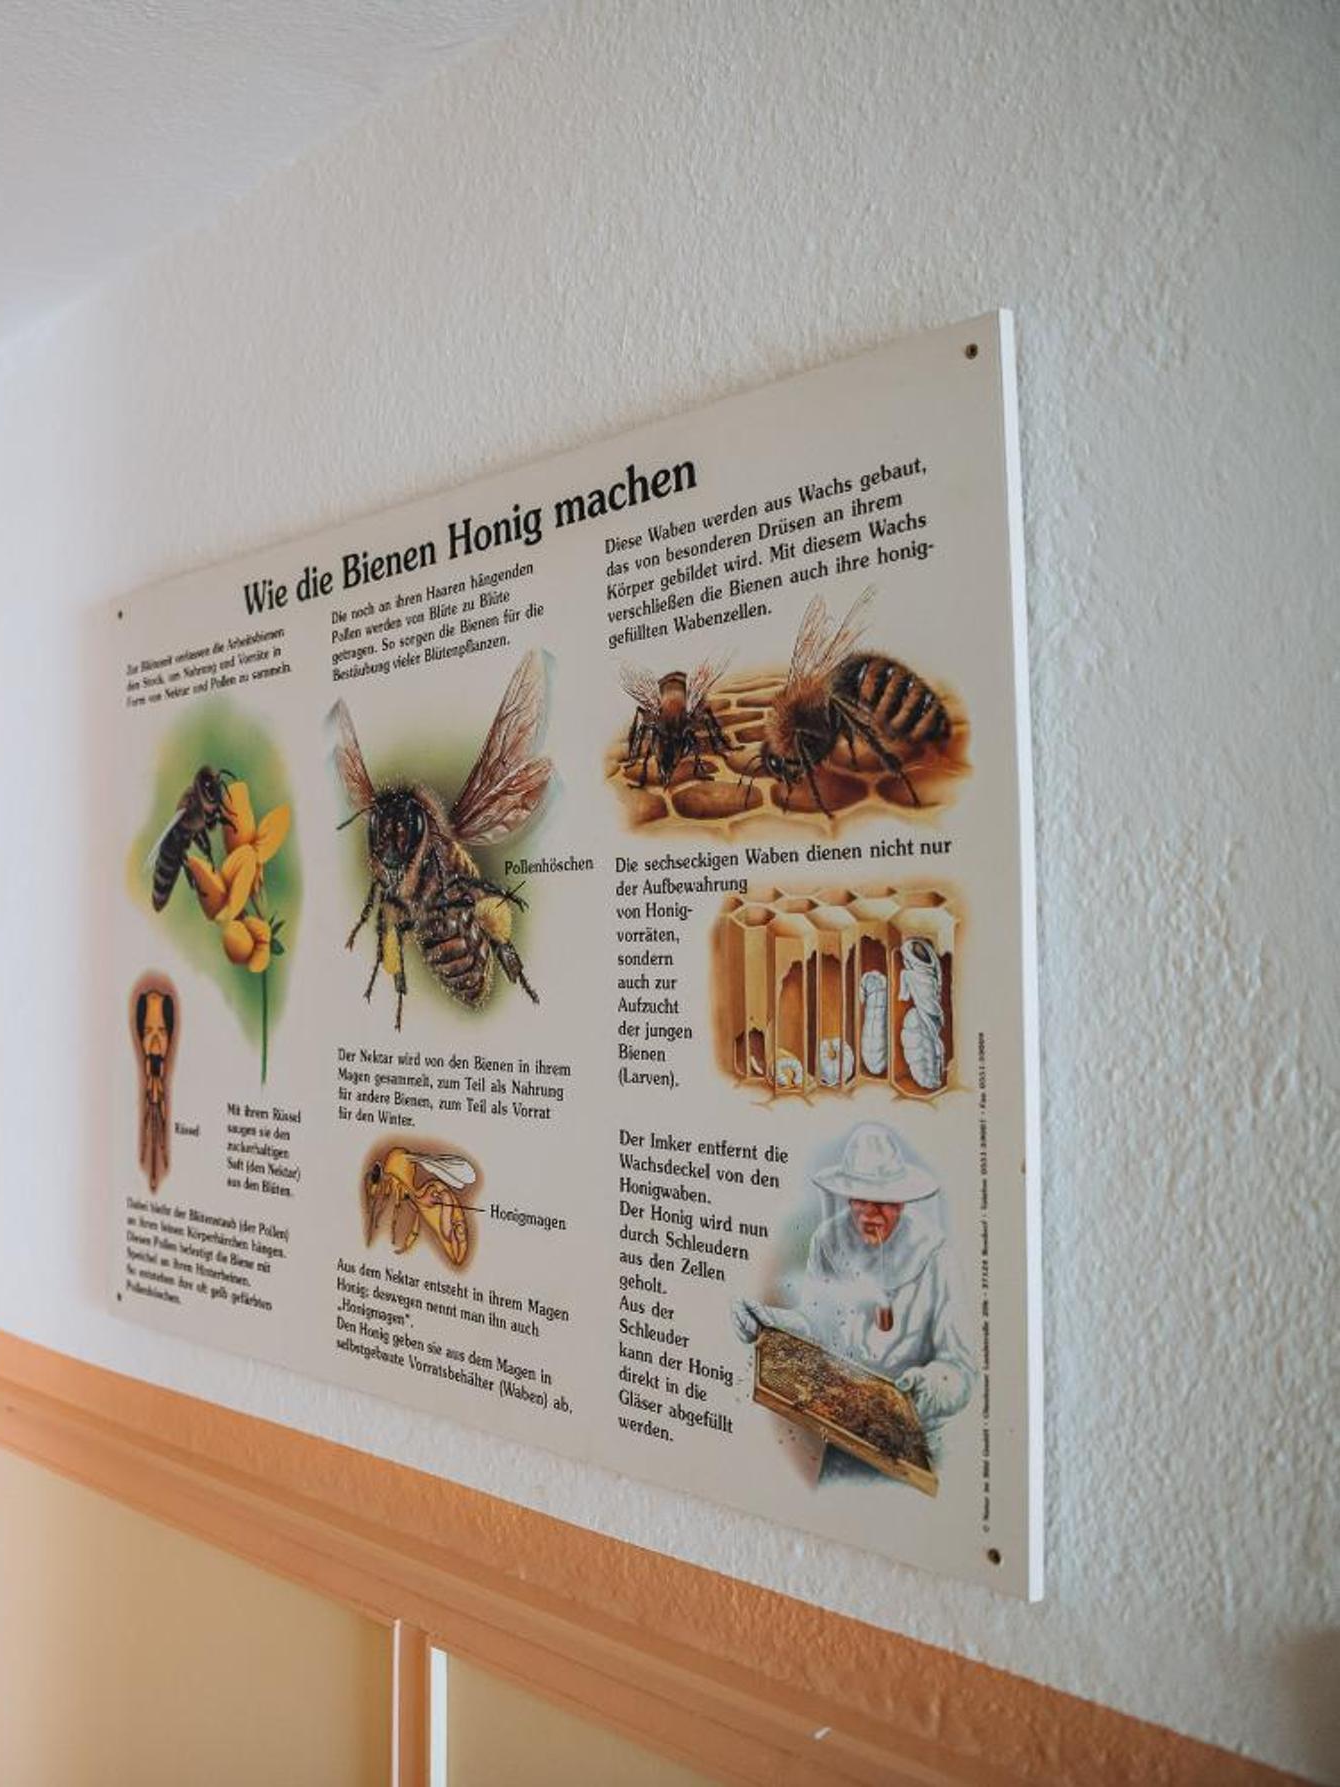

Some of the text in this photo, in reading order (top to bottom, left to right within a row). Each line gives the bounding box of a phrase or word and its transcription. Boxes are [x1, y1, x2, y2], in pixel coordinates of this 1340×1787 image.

[605, 457, 926, 554] Diese Waben werden aus Wachs gebaut,
[243, 461, 697, 615] Wie die Bienen Honig machen
[605, 492, 902, 577] das von besonderen Drüsen an ihrem
[606, 511, 926, 600] Körper gebildet wird. Mit diesem Wachs
[331, 562, 533, 624] Die noch an ihren Haaren hängenden
[607, 540, 934, 623] verschließen die Bienen auch ihre honig-
[381, 637, 395, 651] So
[399, 631, 435, 648] sorgen
[438, 623, 455, 639] die
[459, 615, 499, 634] Bienen
[503, 608, 522, 625] für
[524, 602, 544, 620] die
[608, 601, 772, 649] gefüllten Wabenzellen.
[392, 651, 421, 669] vieler
[424, 635, 510, 663] Blütenpflanzen.
[505, 855, 594, 874] Pollenhöschen
[615, 838, 952, 873] Die sechseckigen Waben dienen nicht nur
[615, 875, 747, 897] der Aufbewahrung
[615, 901, 693, 921] von Honig-
[616, 926, 679, 944] vorräten,
[617, 949, 674, 966] sondern
[617, 973, 678, 991] auch zur
[617, 996, 679, 1014] Aufzucht
[617, 1020, 692, 1042] der jungen
[337, 1047, 571, 1077] Der Nektar wird von den Bienen in ihrem
[618, 1043, 665, 1063] Bienen
[337, 1066, 564, 1101] Magen gesammelt, zum Teil als Nahrung
[618, 1066, 679, 1090] (Larven).
[338, 1086, 551, 1120] für andere Bienen, zum Teil als Vorrat
[338, 1105, 415, 1127] für den Winter.
[619, 1129, 788, 1164] Der Imker entfernt die
[619, 1152, 779, 1188] Wachsdeckel von den
[619, 1175, 711, 1204] Honigwaben.
[490, 1203, 566, 1231] Honigmagen
[619, 1199, 768, 1238] Der Honig wird nun
[619, 1223, 749, 1260] durch Schleudern
[619, 1251, 725, 1281] aus den Zellen
[336, 1257, 569, 1322] Aus dem Nektar entsteht in ihrem Magen
[619, 1273, 667, 1294] geholt.
[372, 1285, 422, 1310] deswegen
[425, 1301, 457, 1318] nennt
[460, 1309, 485, 1325] man
[488, 1311, 506, 1330] ihn
[510, 1320, 539, 1337] auch
[619, 1294, 674, 1320] Aus der
[619, 1317, 689, 1348] Schleuder
[619, 1341, 733, 1387] kann der Honig
[408, 1354, 494, 1391] Vorratsbehälter
[499, 1379, 548, 1410] (Waben)
[553, 1395, 572, 1414] ab.
[618, 1364, 707, 1401] direkt in die
[618, 1387, 733, 1434] Gläser abgefüllt
[617, 1416, 673, 1442] werden.
